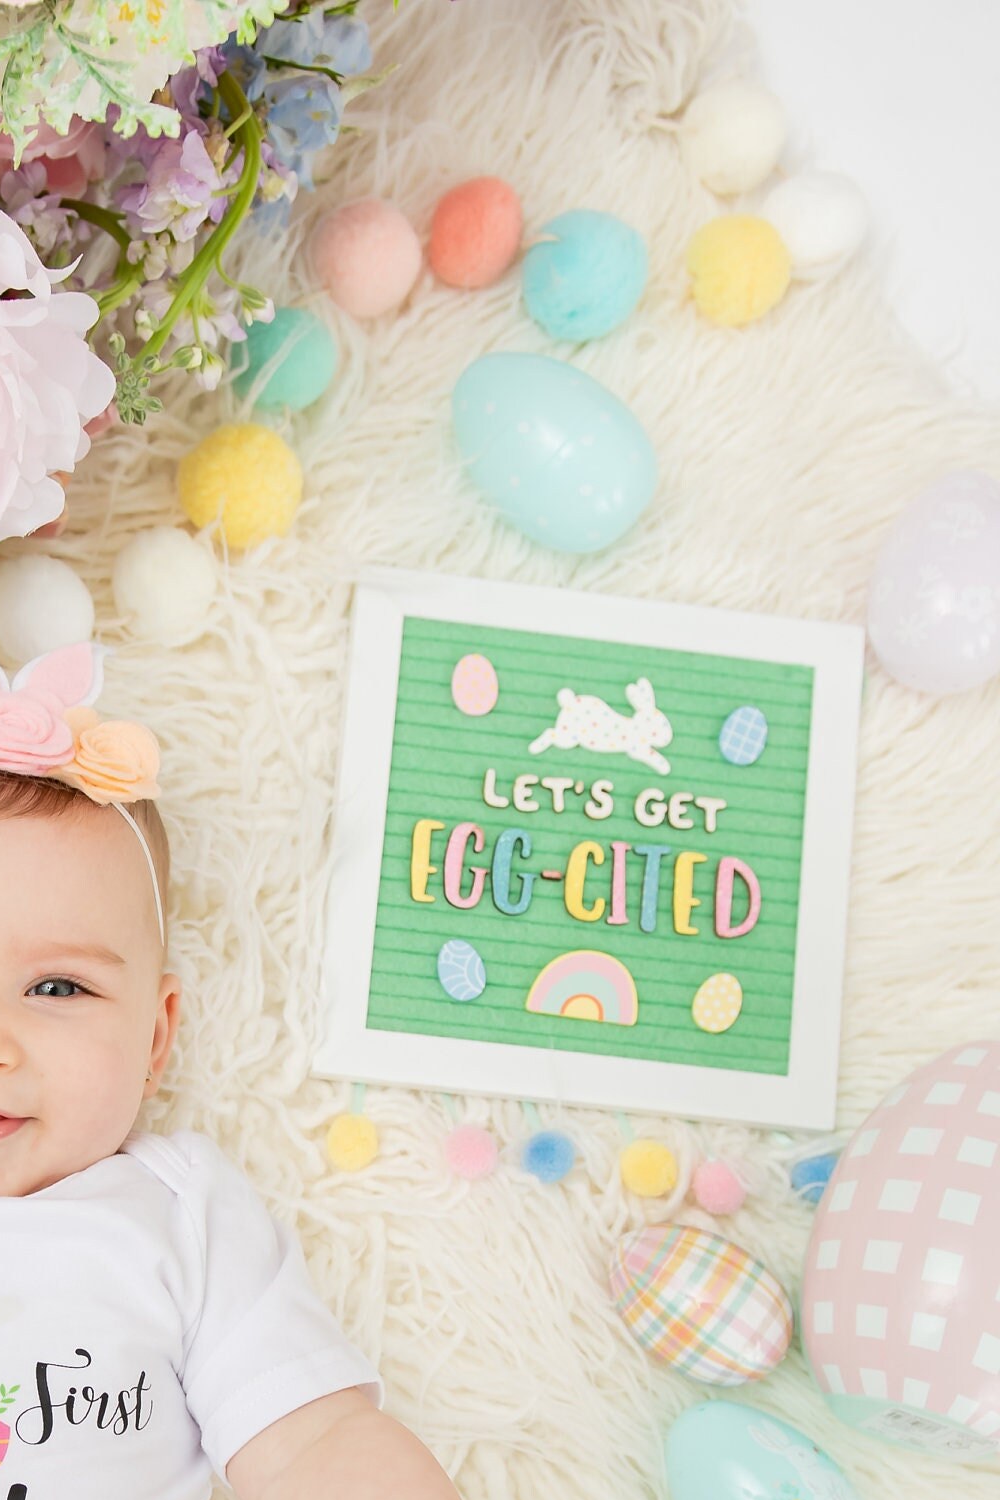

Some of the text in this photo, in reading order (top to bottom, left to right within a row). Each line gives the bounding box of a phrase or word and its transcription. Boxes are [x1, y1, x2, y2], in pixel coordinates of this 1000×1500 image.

[483, 768, 727, 833] LET'S GET
[410, 818, 761, 939] EGG-CITED
[15, 1348, 154, 1445] First
